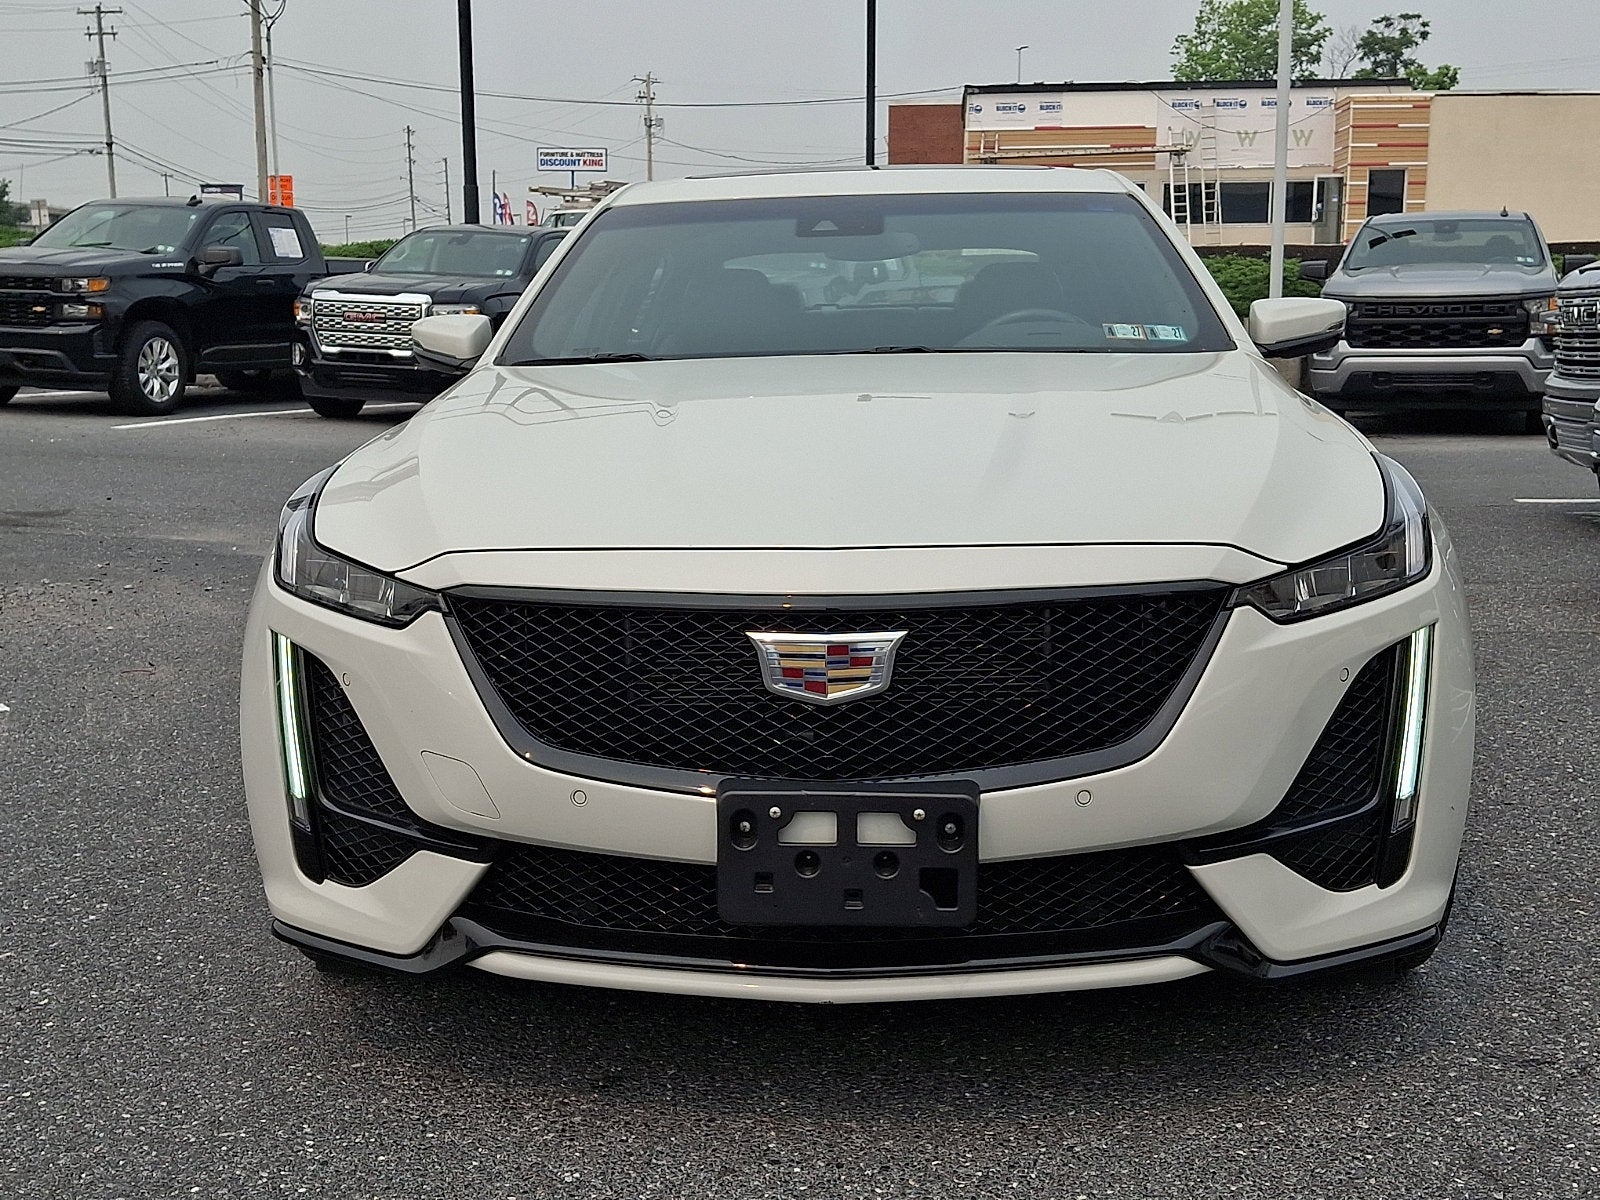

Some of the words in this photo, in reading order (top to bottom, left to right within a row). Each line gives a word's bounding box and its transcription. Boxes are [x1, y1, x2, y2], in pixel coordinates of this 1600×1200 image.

[1235, 129, 1257, 147] W
[1290, 129, 1313, 147] W
[540, 158, 582, 167] DISCOUNT
[582, 158, 604, 167] KING
[1361, 303, 1517, 317] CHEVROLET
[344, 311, 386, 322] GMC
[1130, 326, 1141, 337] 27
[1171, 327, 1182, 338] 27
